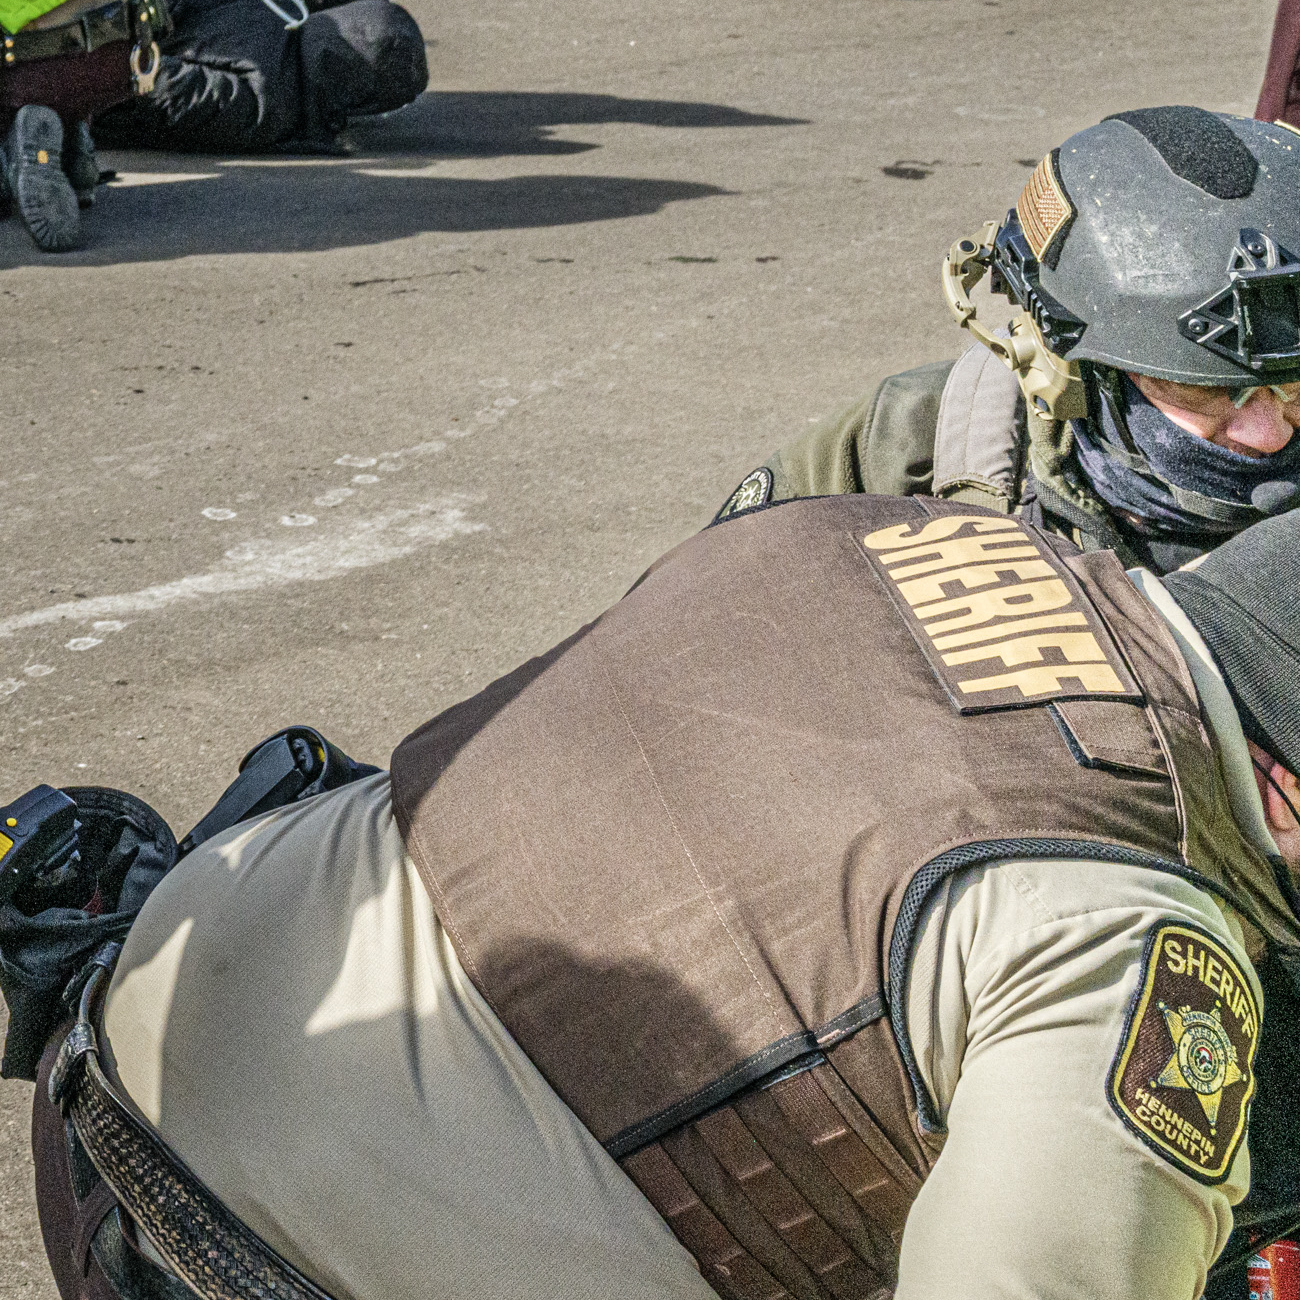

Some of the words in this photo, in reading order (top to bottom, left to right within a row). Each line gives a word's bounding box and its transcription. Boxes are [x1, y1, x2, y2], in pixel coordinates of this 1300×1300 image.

[864, 515, 1126, 698] SHERIFF
[1164, 939, 1255, 1038] SHERIFF
[1136, 1088, 1215, 1158] HENNEPIN
[1136, 1105, 1211, 1166] COUNTY
